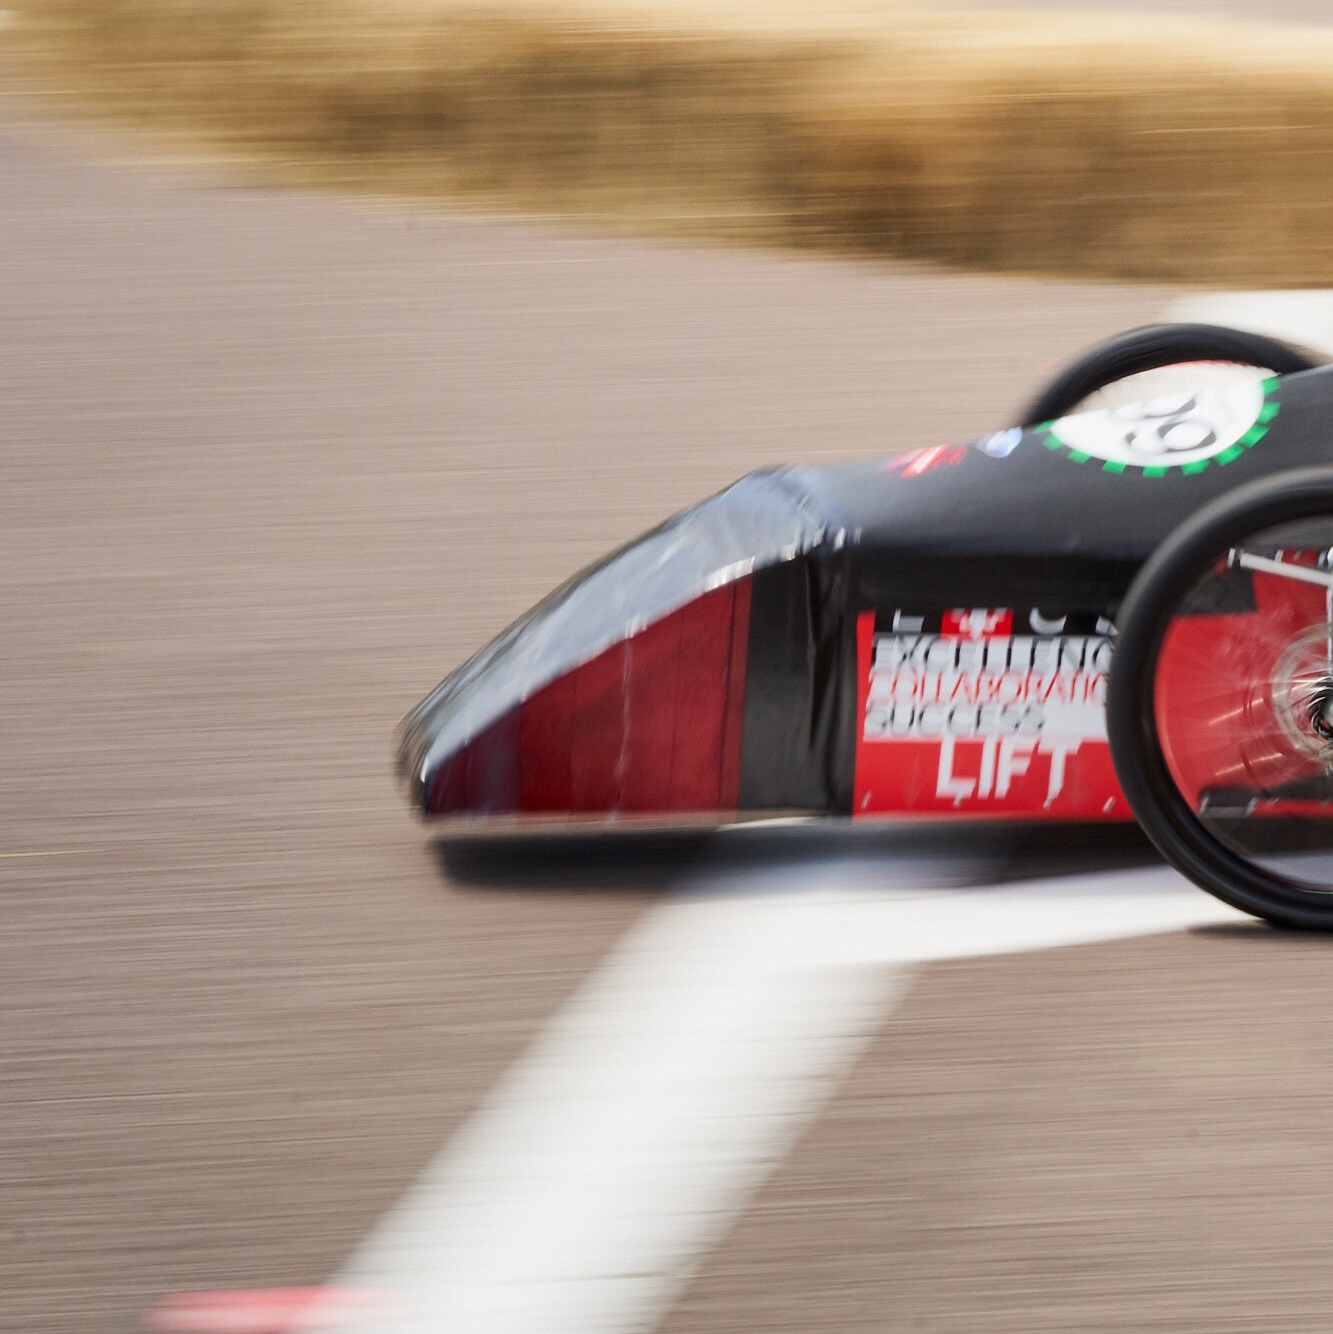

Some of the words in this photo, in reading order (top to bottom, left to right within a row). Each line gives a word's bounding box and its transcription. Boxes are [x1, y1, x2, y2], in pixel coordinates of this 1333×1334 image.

[872, 635, 1112, 669] EXCELLENC
[868, 667, 1108, 704] COLLABORATIO
[865, 702, 1044, 735] SUCCESS
[935, 735, 1085, 799] LIFT
